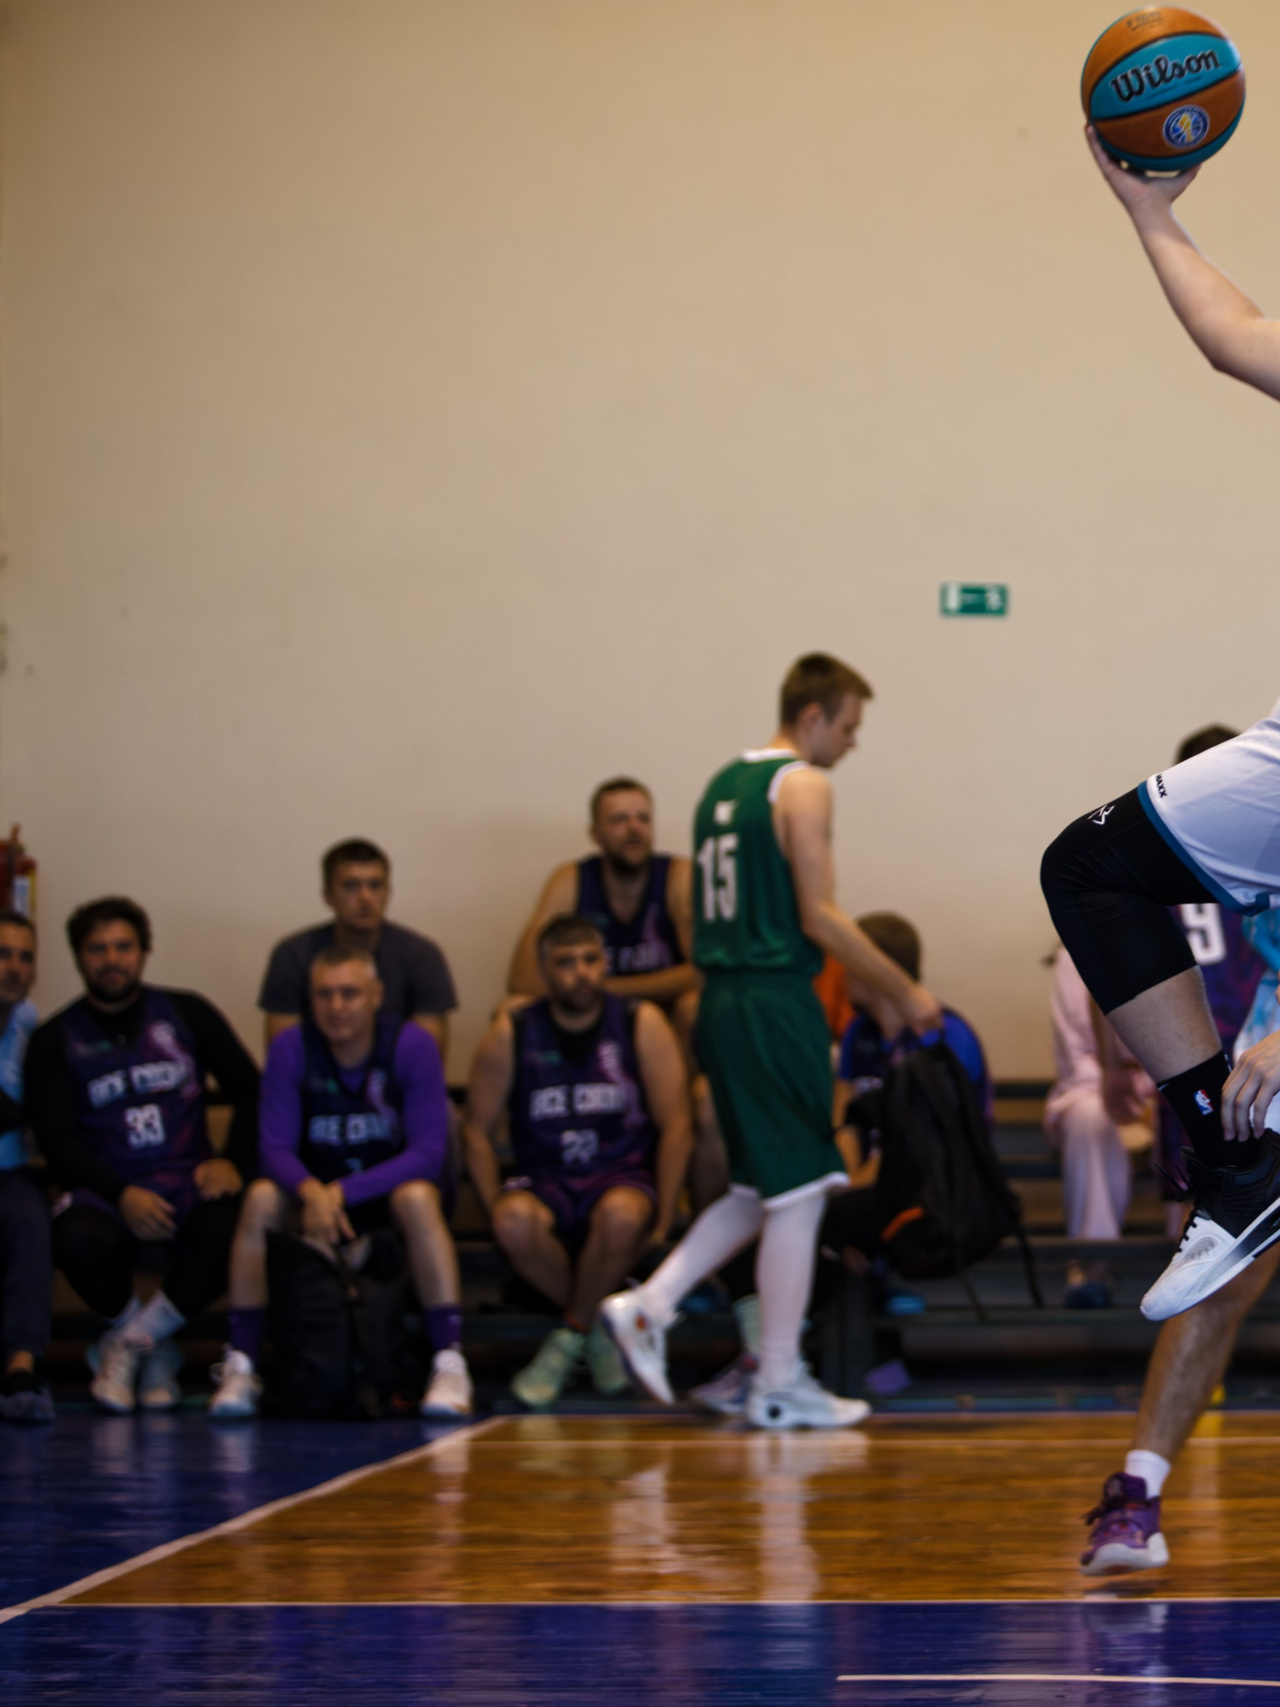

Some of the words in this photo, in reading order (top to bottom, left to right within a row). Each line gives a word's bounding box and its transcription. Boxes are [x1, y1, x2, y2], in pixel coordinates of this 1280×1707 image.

[1110, 50, 1220, 102] Wilson
[698, 832, 738, 922] 15
[125, 1104, 165, 1149] 33
